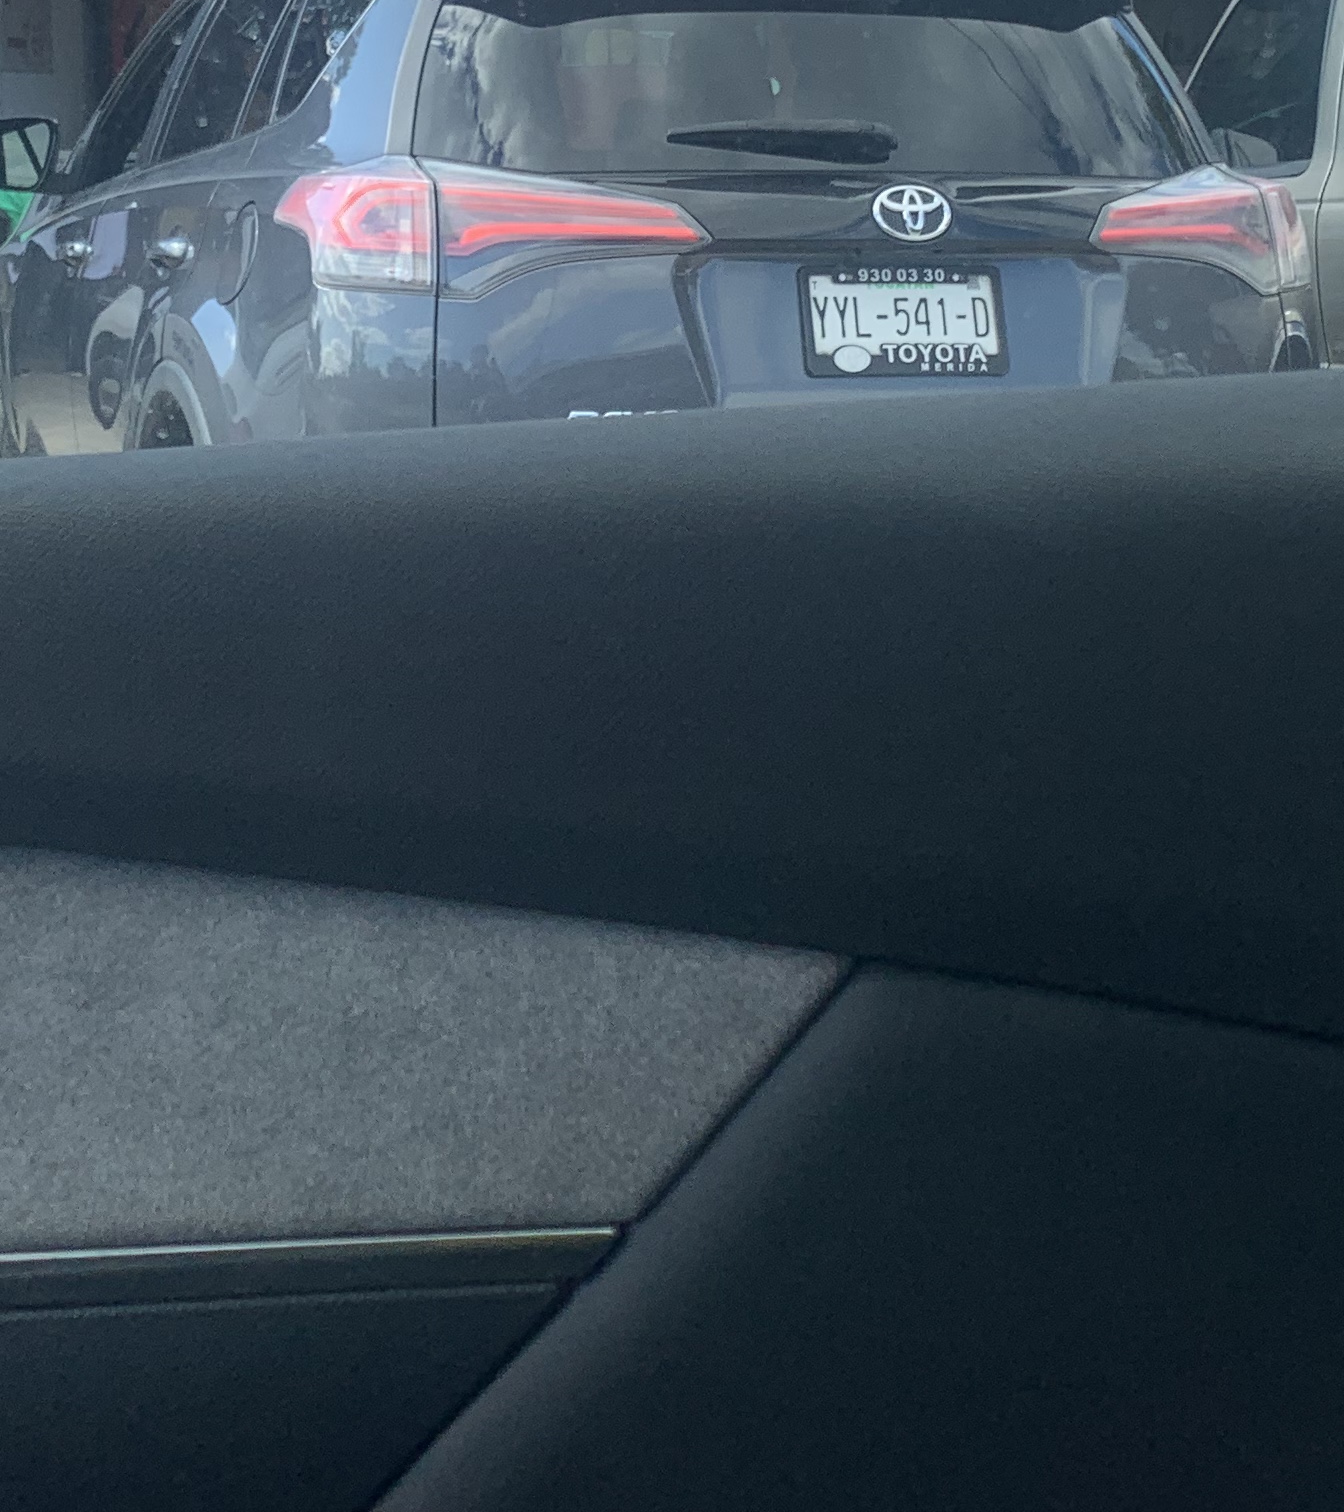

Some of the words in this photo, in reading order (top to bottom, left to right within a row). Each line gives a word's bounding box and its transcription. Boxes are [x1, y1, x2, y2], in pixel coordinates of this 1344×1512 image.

[858, 268, 892, 282] 930
[896, 268, 919, 282] 03
[923, 268, 946, 282] 30
[812, 296, 991, 339] YYL-541-D
[881, 343, 988, 364] TOYOTA
[920, 362, 989, 373] MERIDA
